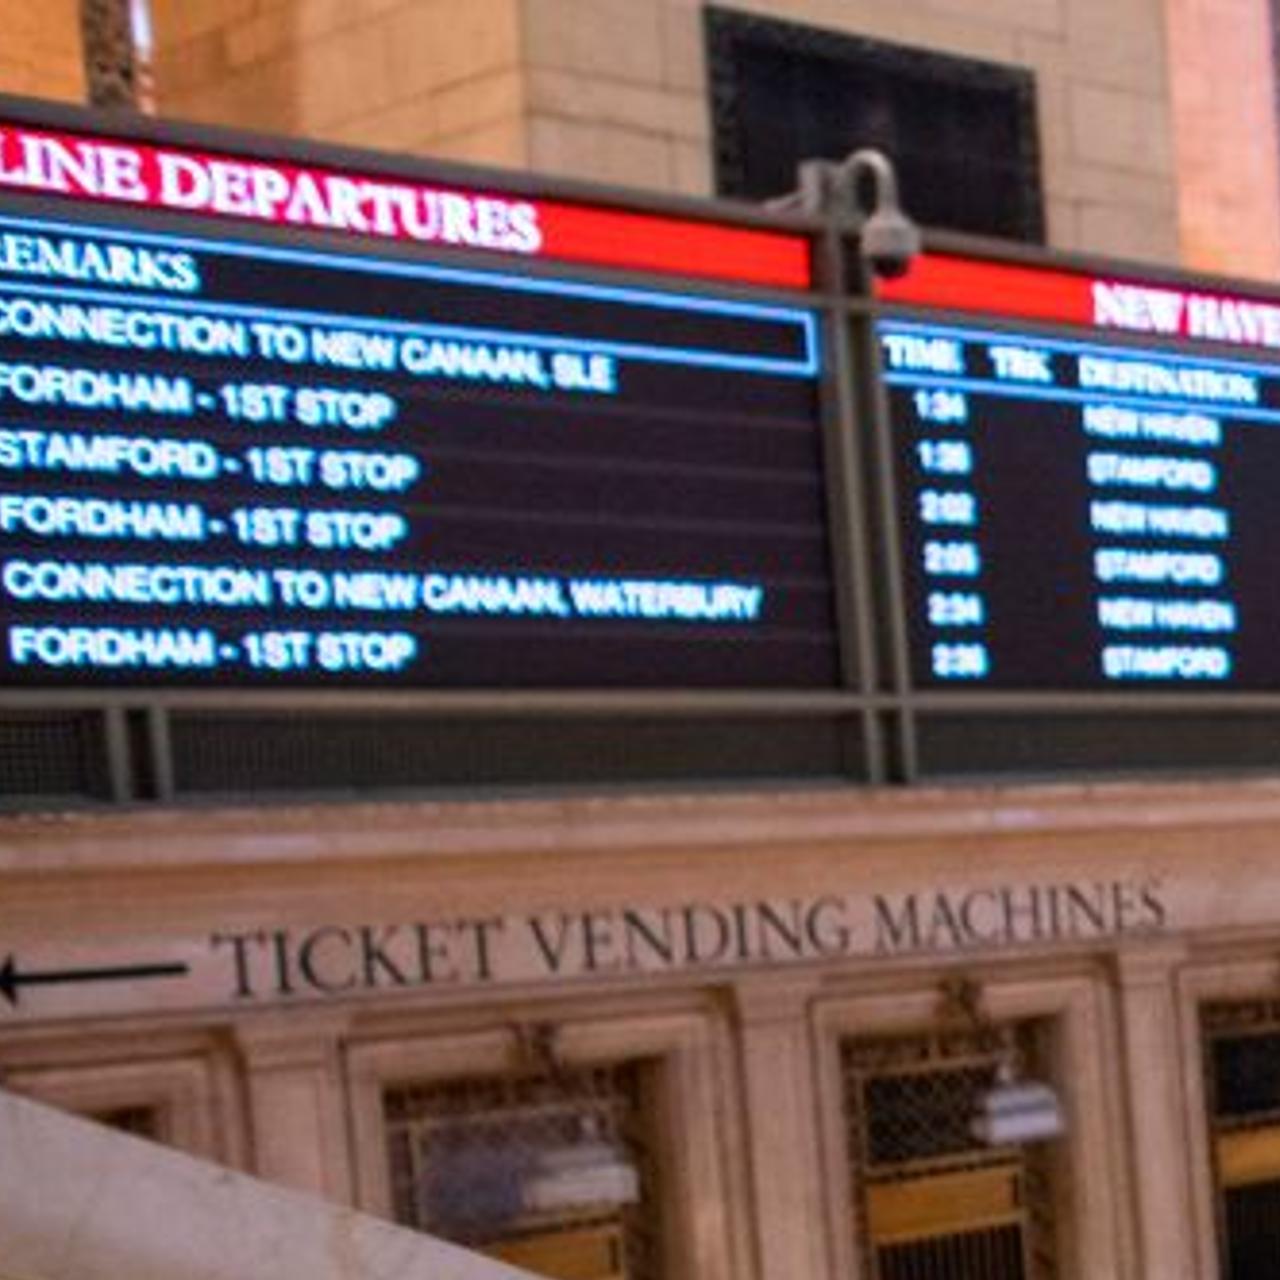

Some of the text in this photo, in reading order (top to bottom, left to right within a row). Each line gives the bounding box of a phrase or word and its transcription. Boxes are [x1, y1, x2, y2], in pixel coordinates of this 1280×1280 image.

[0, 132, 542, 253] LINE DEPARTURES
[0, 234, 200, 291] EMARKS
[1092, 282, 1182, 333] NEW
[251, 322, 307, 361] TO
[311, 324, 401, 367] NEW
[551, 353, 612, 390] SLE
[880, 334, 962, 372] TIME
[220, 383, 288, 420] 1ST
[295, 388, 393, 427] STOP
[0, 429, 218, 476] STAMFORD
[247, 446, 312, 483] 1ST
[319, 450, 417, 488] STOP
[0, 495, 203, 537] FORDHAM
[233, 507, 299, 544] 1ST
[306, 511, 403, 549] STOP
[2, 561, 269, 604] CONNECTION
[274, 569, 329, 607] TO
[332, 573, 417, 608] NEW
[569, 581, 759, 618] WATERBURY
[9, 627, 215, 665] FORDHAM
[243, 630, 310, 668] 1ST
[316, 631, 414, 669] STOP
[210, 881, 1167, 999] TICKET VENDING MACHINES
